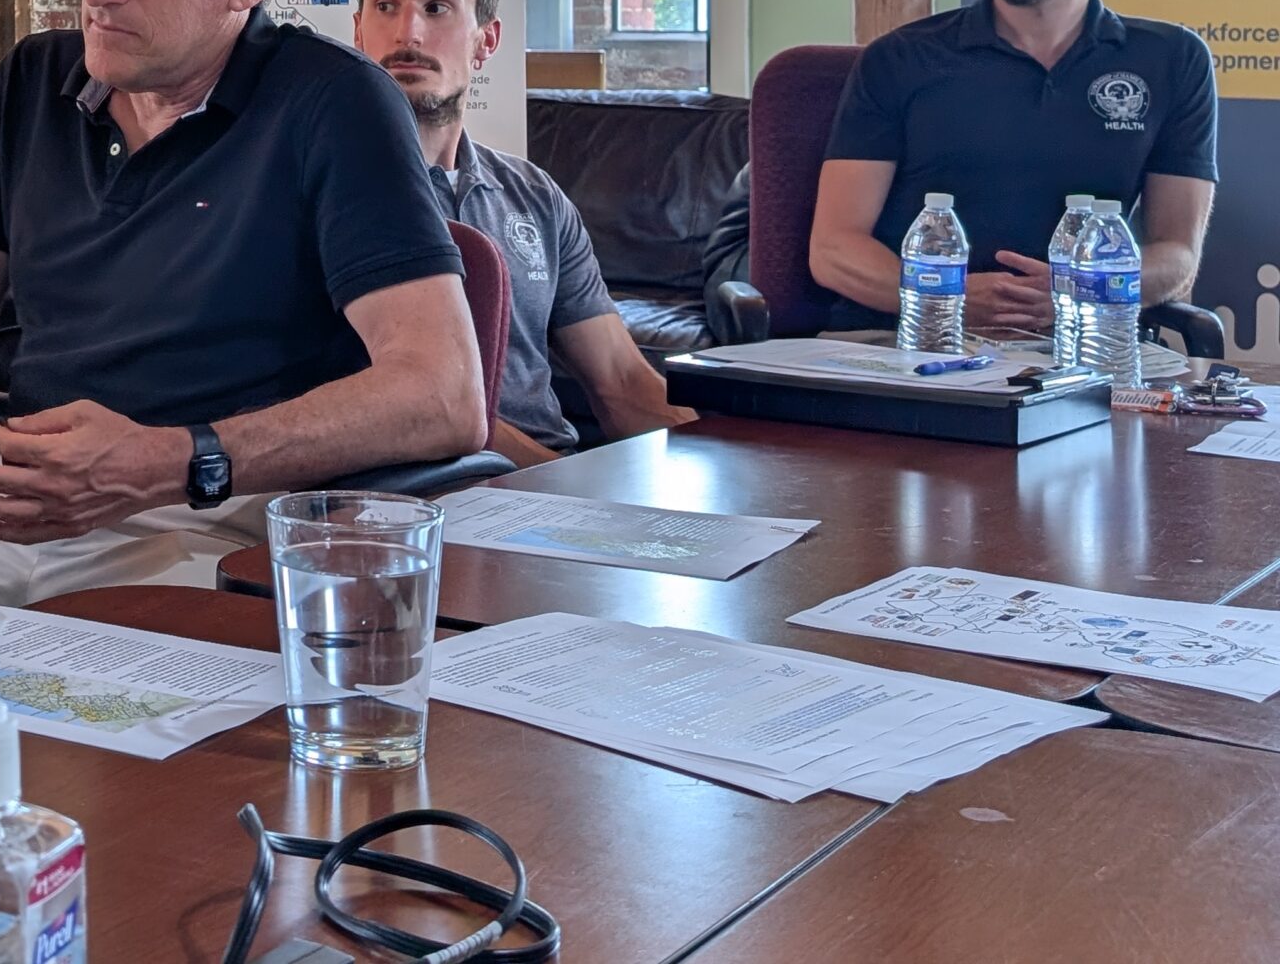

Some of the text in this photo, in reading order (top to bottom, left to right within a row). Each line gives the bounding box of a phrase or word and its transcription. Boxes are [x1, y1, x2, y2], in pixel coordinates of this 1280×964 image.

[1194, 22, 1280, 43] rkforce
[466, 101, 488, 110] ears
[1104, 121, 1145, 131] HEALTH
